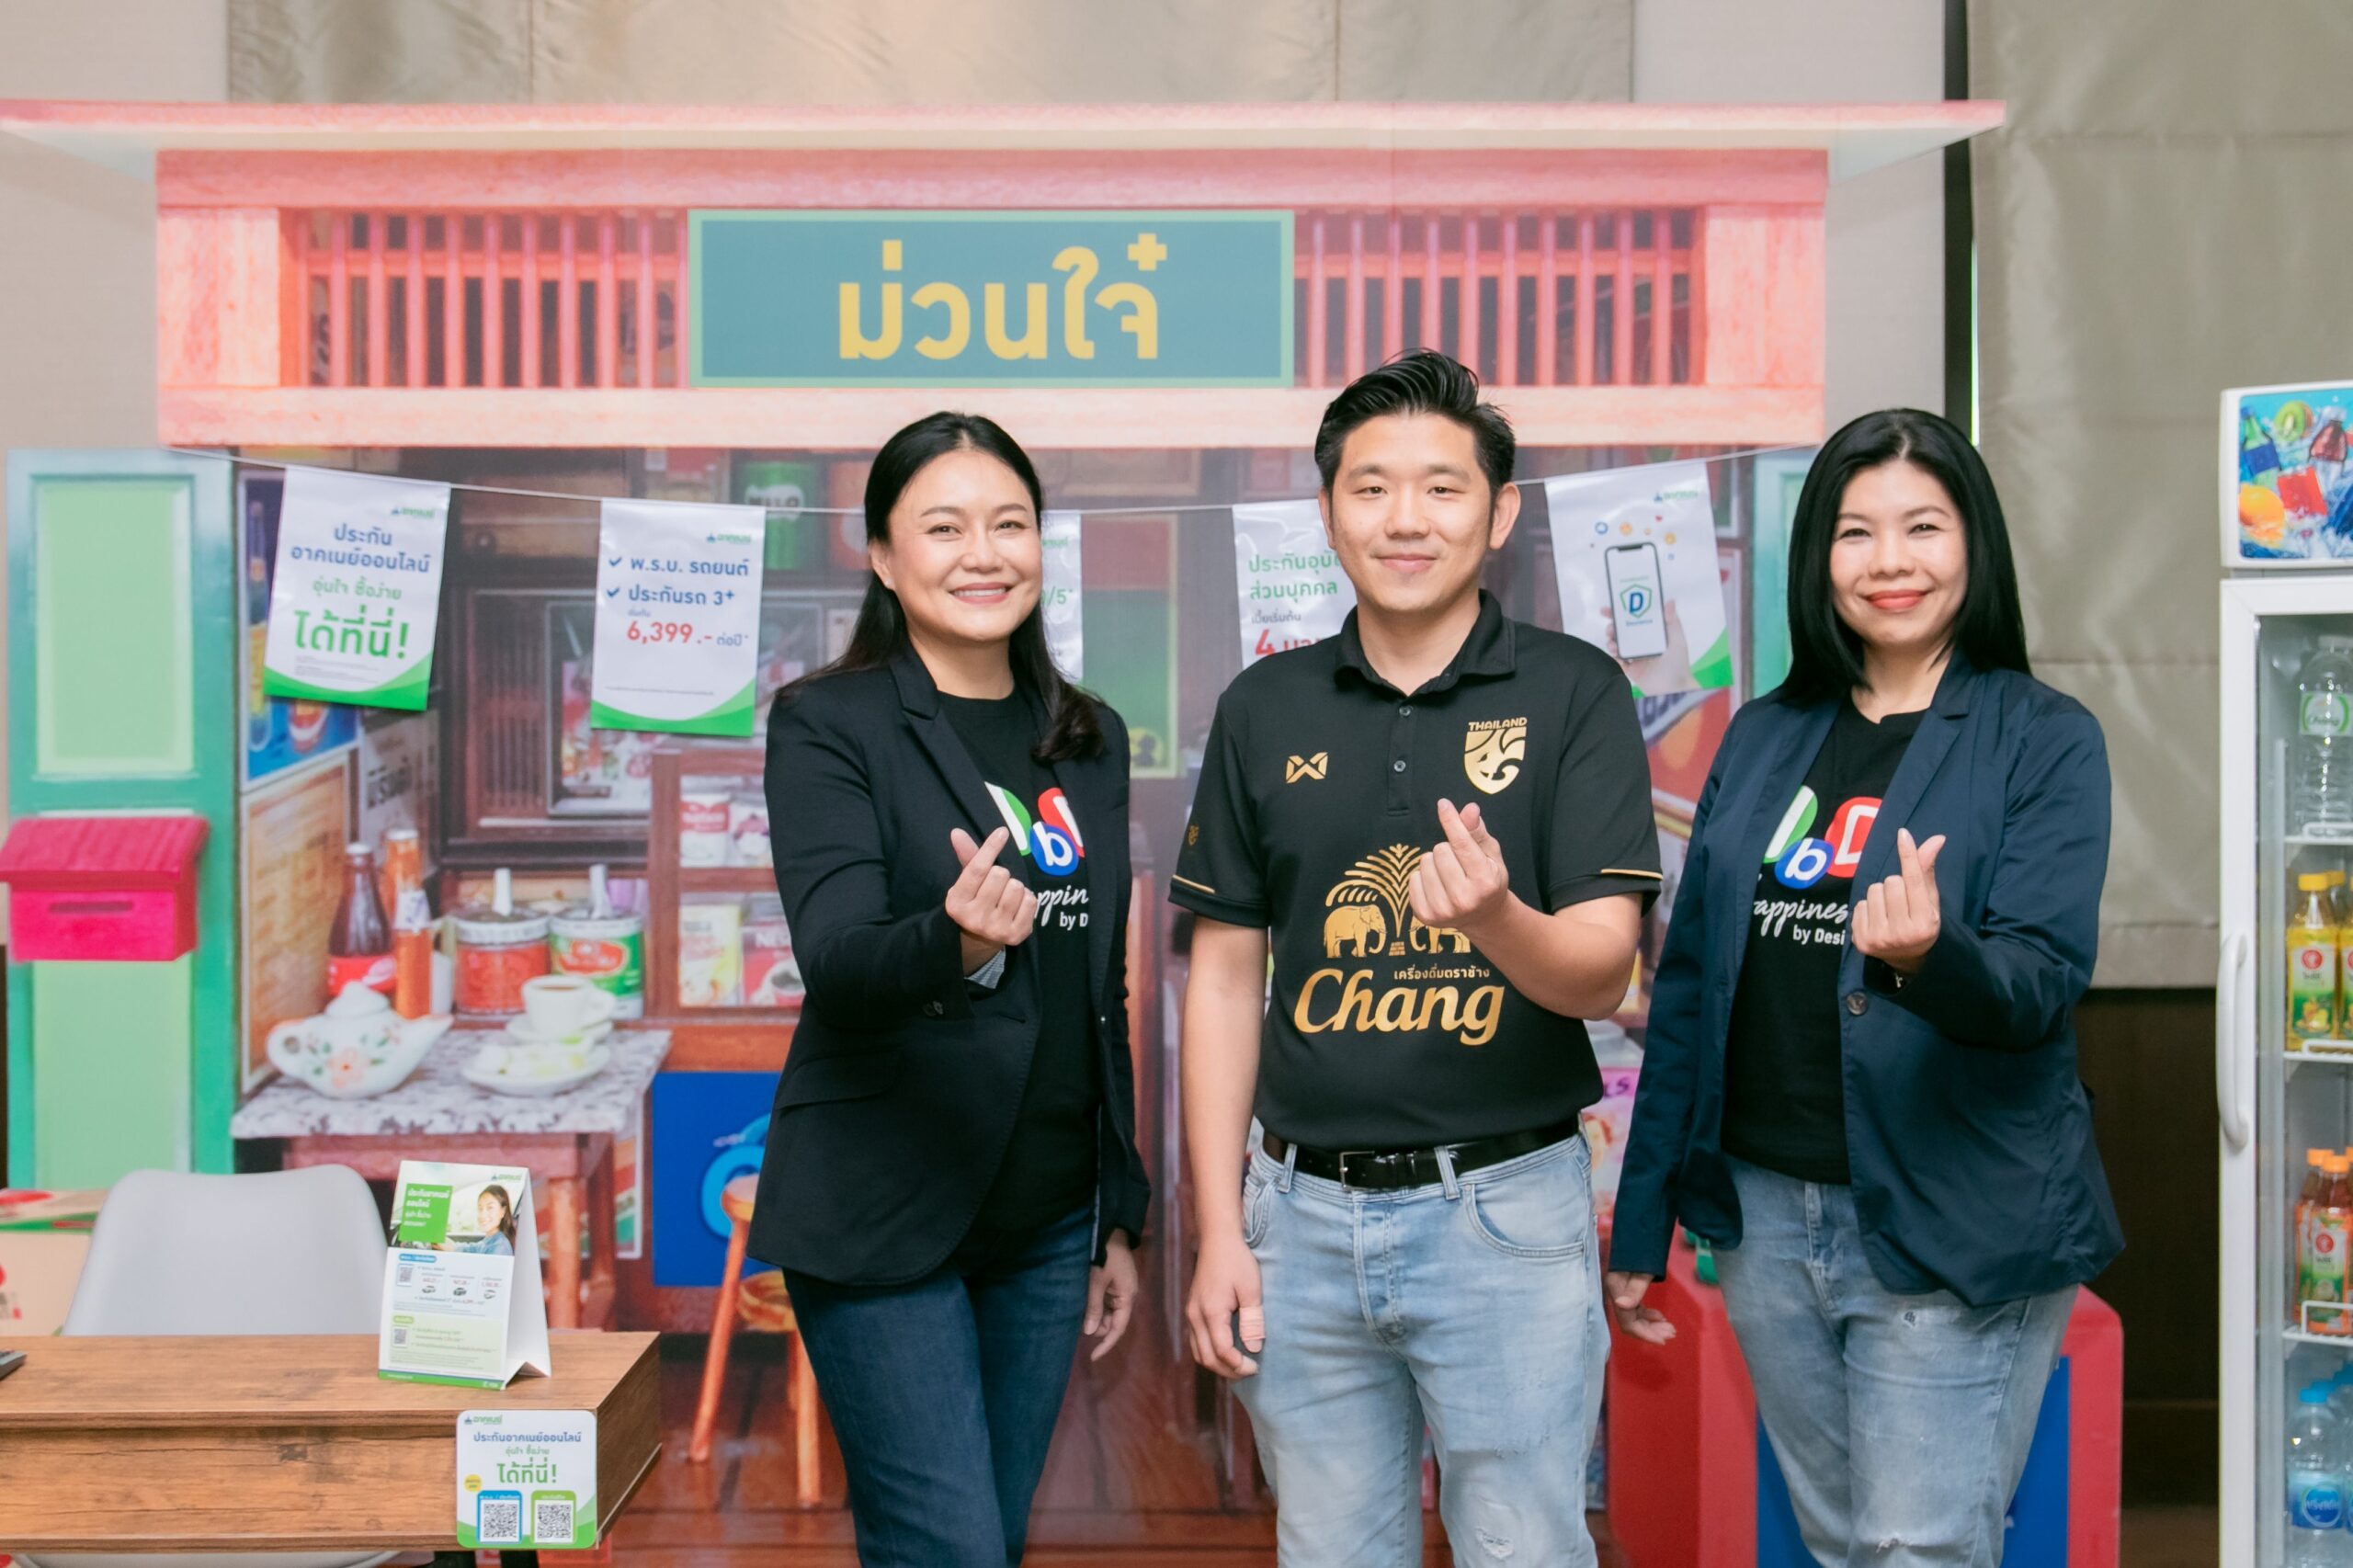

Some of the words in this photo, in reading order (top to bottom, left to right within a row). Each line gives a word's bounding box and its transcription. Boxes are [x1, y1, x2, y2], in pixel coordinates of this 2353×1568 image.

[839, 233, 1167, 361] ม่วนใจ๋
[334, 523, 392, 547] ประกัน
[290, 544, 432, 574] อาคเนย์ออนไลน์
[630, 557, 684, 574] พ.ร.บ.
[689, 558, 750, 577] รถยนต์
[629, 584, 707, 606] ประกันรถ
[1249, 579, 1338, 603] ส่วนบุคคล
[293, 603, 409, 660] ได้ที่นี่!
[1468, 717, 1528, 732] THAILAND
[1059, 911, 1076, 931] by
[1792, 923, 1812, 945] by
[1393, 964, 1491, 982] เครื่องดื่มตราช้าง
[1293, 968, 1506, 1046] Chang
[496, 1457, 557, 1483] ได้ที่นี่!
